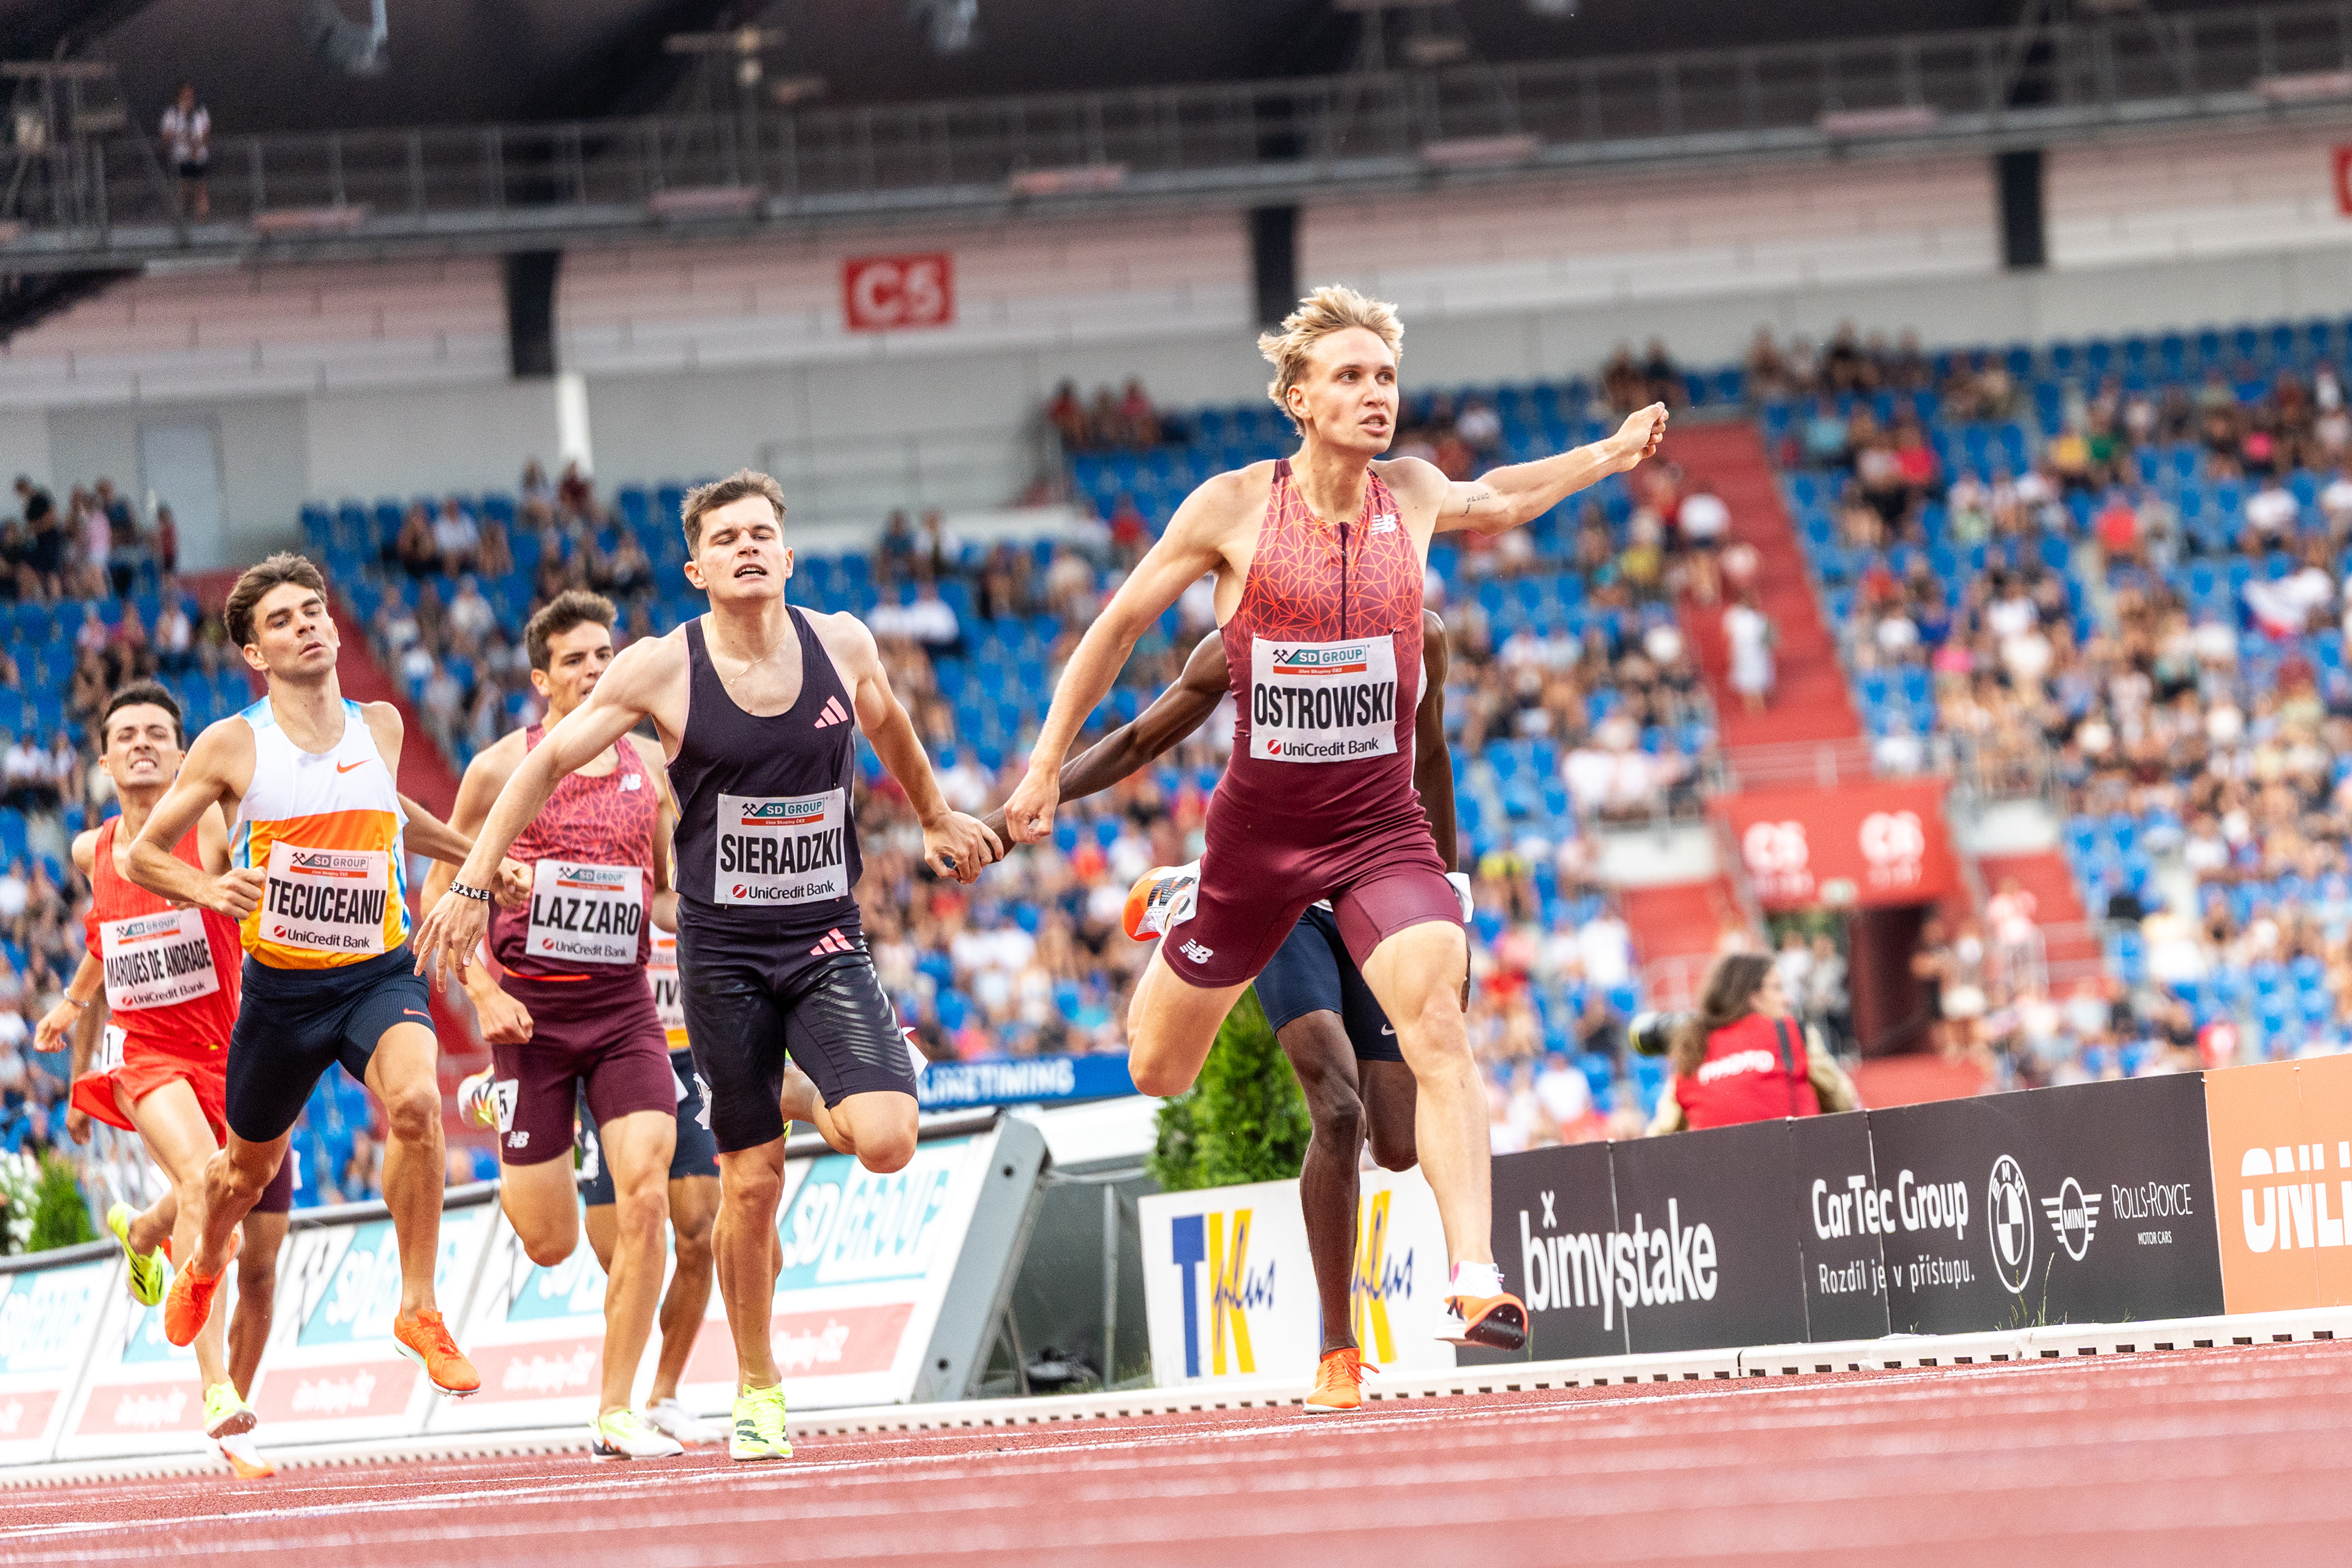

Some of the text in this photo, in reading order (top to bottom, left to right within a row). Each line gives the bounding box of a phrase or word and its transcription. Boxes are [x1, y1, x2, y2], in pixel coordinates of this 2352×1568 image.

[854, 263, 941, 323] C5
[1467, 492, 1489, 502] SPEED
[1299, 649, 1363, 663] SD GROUP
[1255, 682, 1395, 729] OSTROWSKI
[1283, 737, 1379, 756] UniCredit Bank
[766, 801, 823, 815] SD GROUP
[313, 856, 366, 868] SD GROUP
[720, 827, 843, 875] SIERADZKI
[579, 870, 624, 882] SD GROUP
[268, 876, 386, 925] TECUCEANU
[748, 880, 835, 900] UniCredit Bank
[146, 918, 176, 932] GROUP
[532, 894, 641, 937] LAZZARO
[287, 929, 370, 948] UniCredit Bank
[556, 941, 627, 959] UniCredit Bank
[107, 938, 212, 989] MARQUES DE ANDRADE
[134, 981, 206, 1005] UniCredit Bank
[1697, 1050, 1776, 1086] PHOTO
[1812, 1169, 1970, 1240] CarTec Group
[2111, 1182, 2193, 1219] ROLLS-ROYCE
[2063, 1208, 2085, 1230] MINI
[2138, 1231, 2173, 1245] MOTOR CARS
[1520, 1189, 1717, 1331] bimystake
[1819, 1254, 1975, 1296] Rozdíl je v přístupu.
[1172, 1208, 1256, 1378] TK
